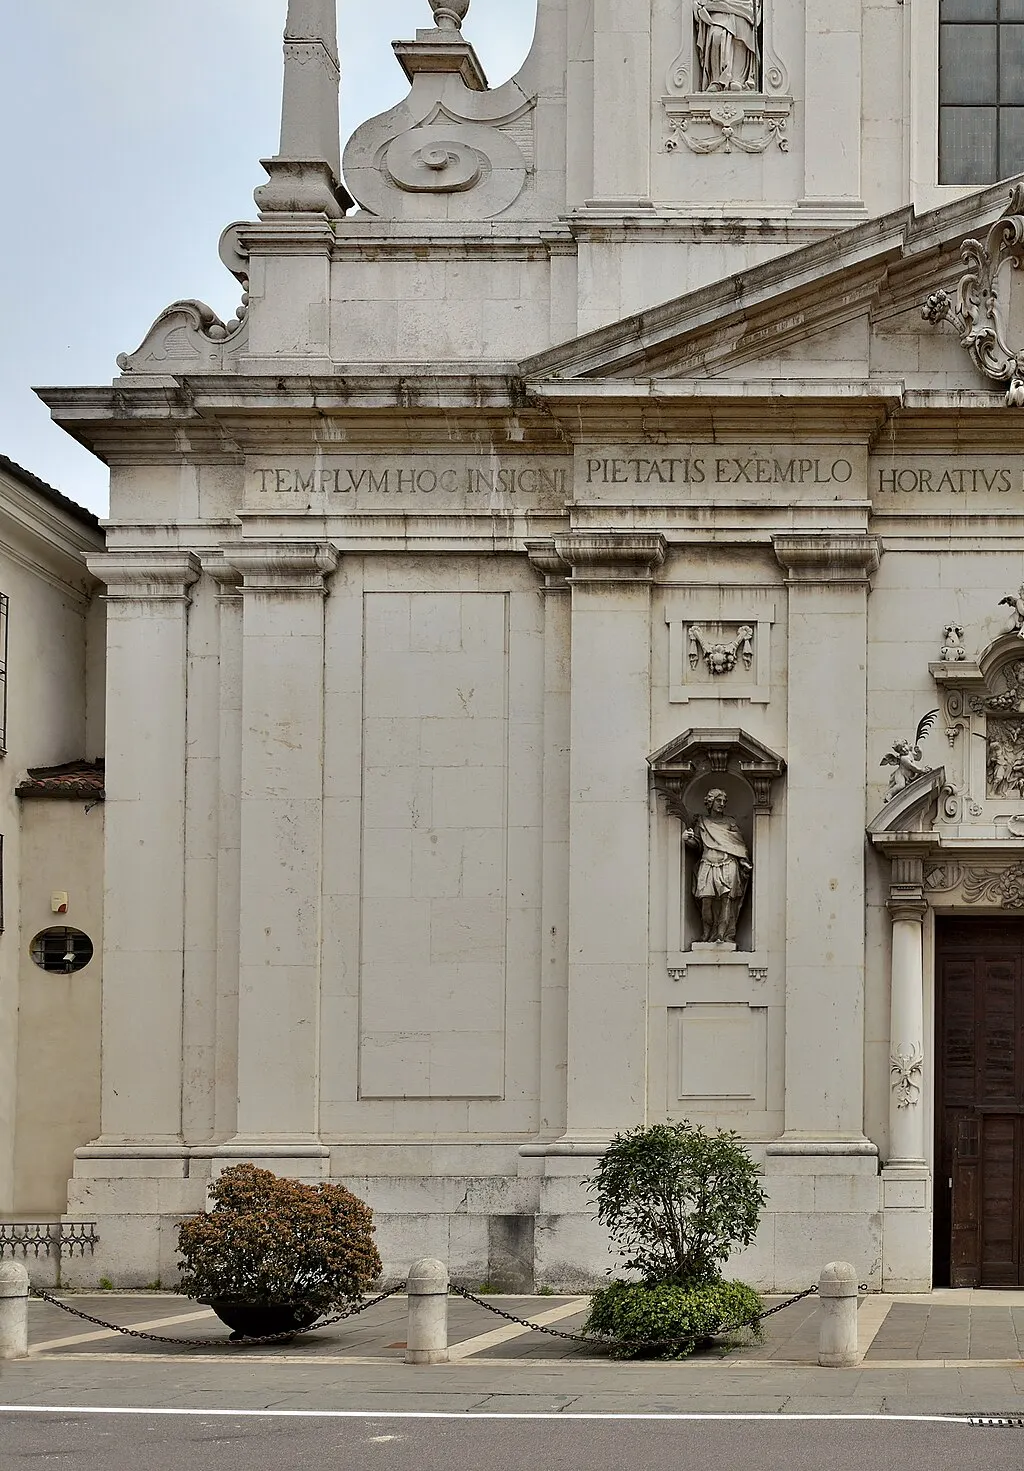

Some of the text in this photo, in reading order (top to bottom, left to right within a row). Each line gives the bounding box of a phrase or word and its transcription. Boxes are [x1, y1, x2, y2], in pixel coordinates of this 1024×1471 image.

[253, 468, 389, 493] TEMPLVM
[396, 468, 457, 493] HOC
[466, 468, 567, 493] INSIGNI
[585, 458, 706, 483] PIETATIS
[714, 458, 853, 483] EXEMPLO
[878, 468, 1012, 493] HORATIVS
